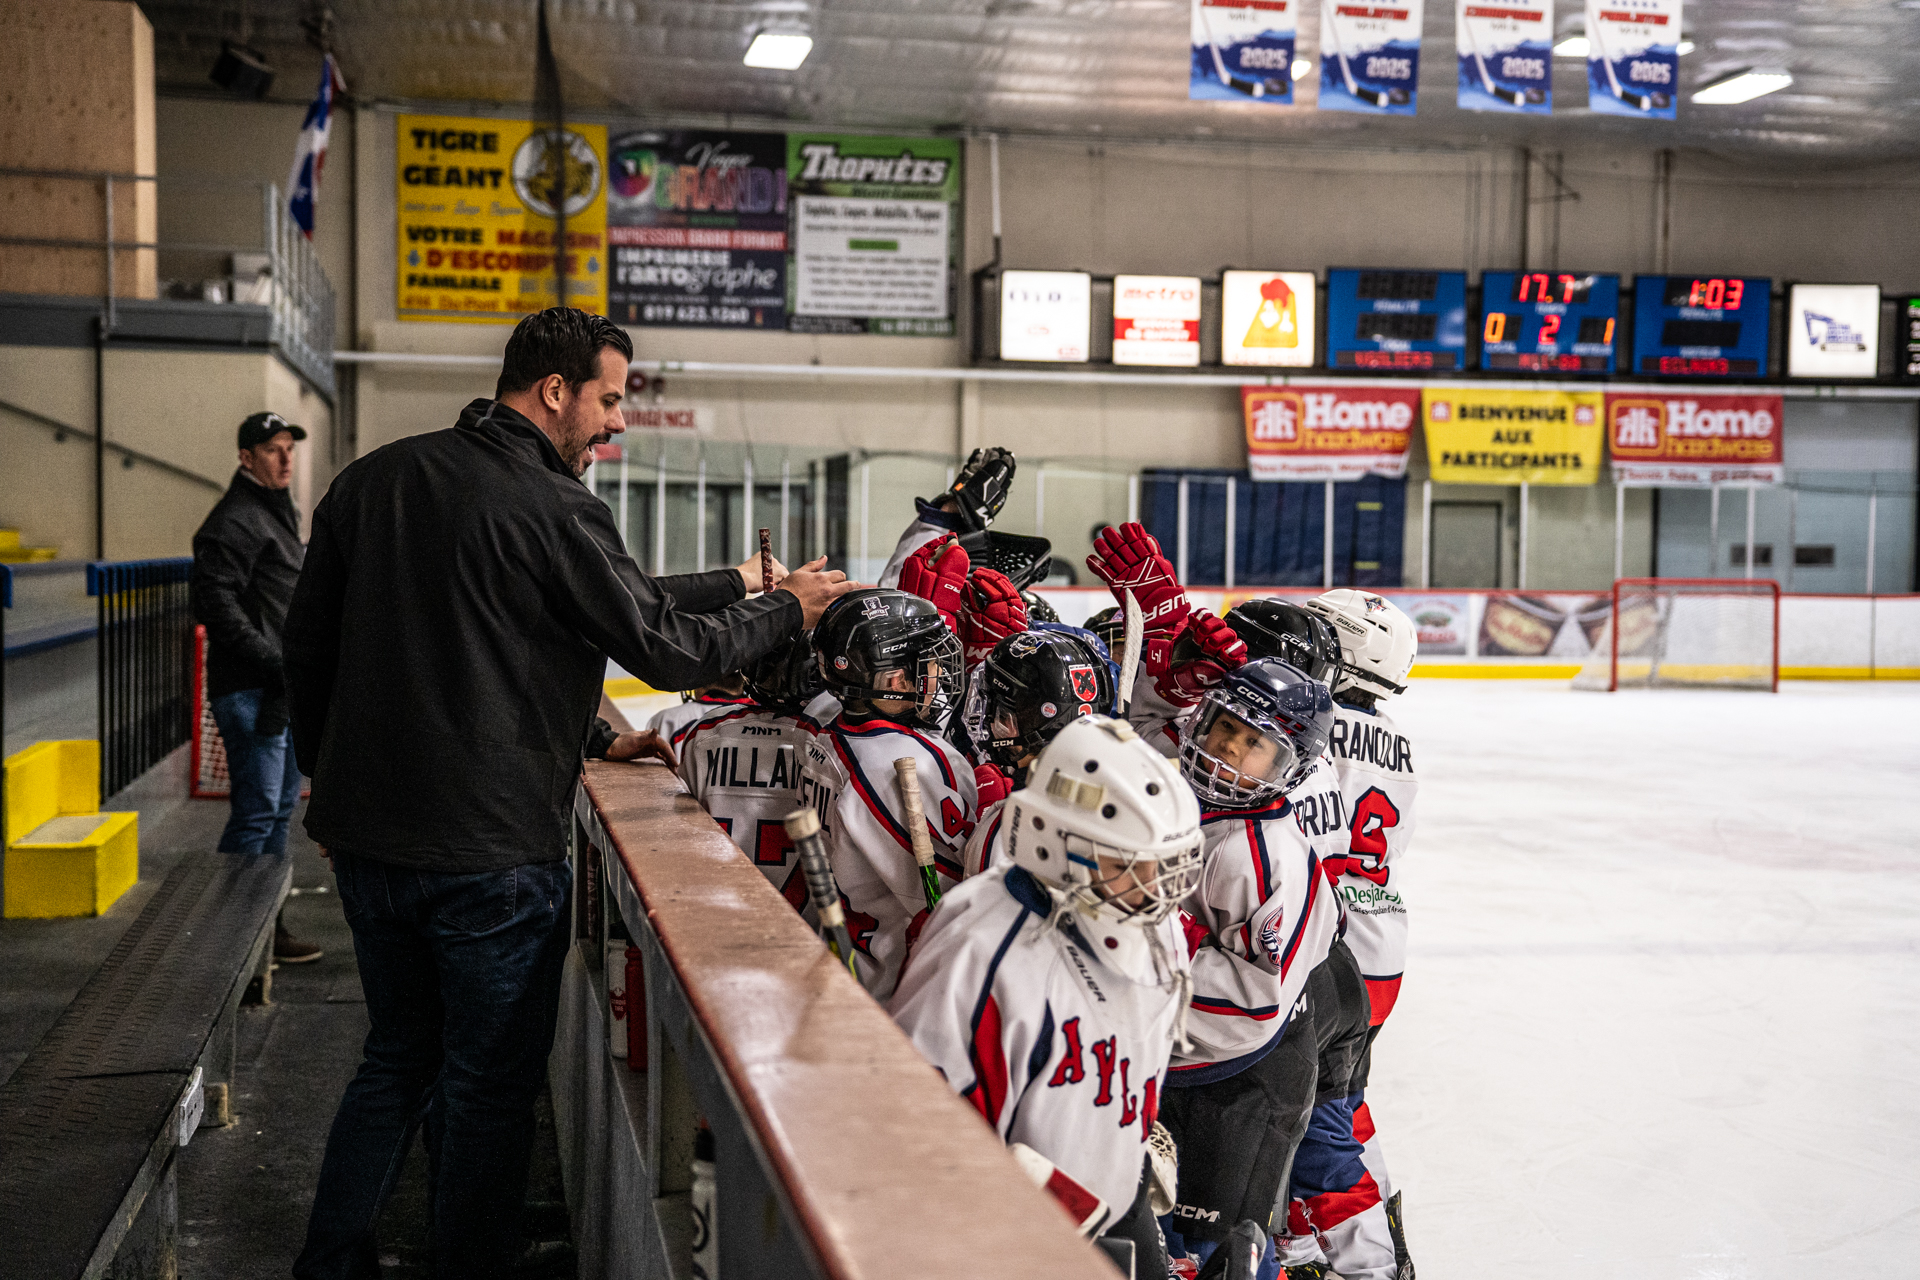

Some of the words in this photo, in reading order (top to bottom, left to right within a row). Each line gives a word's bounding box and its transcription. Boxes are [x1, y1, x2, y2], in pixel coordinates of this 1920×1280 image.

[1240, 46, 1288, 70] 2025
[1366, 56, 1412, 80] 2025
[1502, 56, 1545, 80] 2025
[1629, 60, 1672, 84] 2025
[411, 128, 498, 153] TIGRE
[406, 225, 484, 245] VOTRE
[1122, 286, 1194, 302] metro
[1484, 312, 1506, 343] 0
[1538, 314, 1561, 345] 2
[1603, 317, 1615, 345] 1
[1303, 393, 1412, 430] Home
[1458, 404, 1567, 421] BIENVENUE
[1666, 401, 1774, 437] Home
[1304, 430, 1410, 450] hardware
[1492, 429, 1533, 444] AUX
[1666, 436, 1775, 458] hardware
[1441, 452, 1582, 469] PARTICIPANTS
[1336, 616, 1365, 636] BAUER
[882, 642, 908, 654] CCM
[1280, 633, 1311, 651] CCM
[1236, 685, 1272, 709] CCM
[741, 725, 782, 736] MNM
[992, 739, 1014, 748] CCM
[1330, 716, 1414, 774] RANCOUR
[1066, 945, 1107, 1002] BAUER
[1173, 1203, 1221, 1223] CCM
